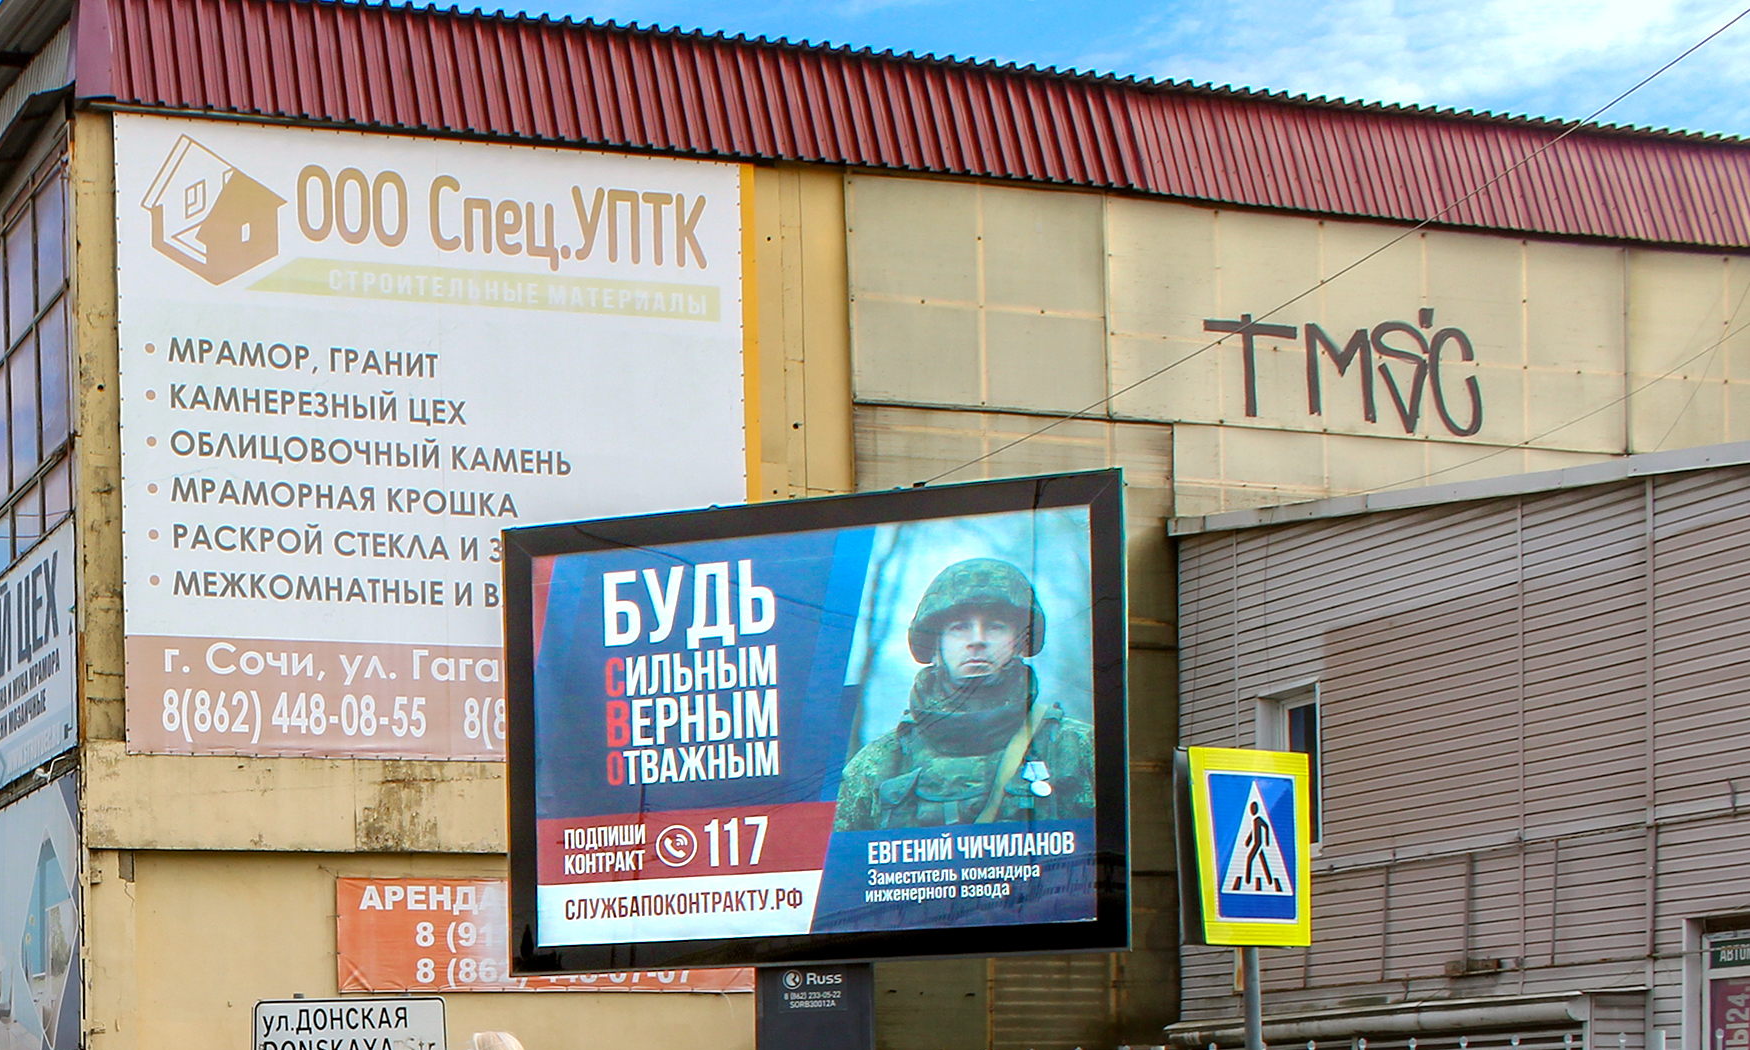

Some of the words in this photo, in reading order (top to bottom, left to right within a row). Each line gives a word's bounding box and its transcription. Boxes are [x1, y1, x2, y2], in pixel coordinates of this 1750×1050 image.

[296, 164, 409, 248] ООО
[428, 174, 709, 271] Спец.УПТК
[329, 269, 540, 304] СТРОИТЕЛЬНЫЕ
[547, 283, 707, 316] МАТЕРИАЛЫ
[168, 337, 320, 375] МРАМОР,
[328, 348, 439, 378] ГРАНИТ
[169, 384, 398, 424] КАМНЕРЕЗНЫЙ
[409, 398, 467, 426] ЦЕХ
[170, 429, 440, 470] ОБЛИЦОВОЧНЫЙ
[452, 445, 572, 476] КАМЕНЬ
[171, 477, 376, 511] МРАМОРНАЯ
[387, 488, 518, 518] КРОШКА
[173, 523, 323, 556] РАСКРОЙ
[334, 532, 449, 561] СТЕКЛА
[460, 537, 478, 562] И
[17, 550, 59, 664] ЦЕХ
[173, 571, 444, 606] МЕЖКОМНАТНЫЕ
[455, 581, 473, 607] И
[602, 559, 776, 649] БУДЬ
[163, 648, 190, 673] г.
[205, 642, 326, 681] Сочи,
[340, 653, 397, 685] ул.
[604, 645, 778, 699] СИЛЬНЫМ
[162, 688, 261, 744] 8(862)
[272, 692, 427, 738] 448-08-55
[606, 688, 779, 749] ВЕРНЫМ
[606, 742, 780, 787] ОТВАЖНЫМ
[564, 824, 646, 850] ПОДПИШИ
[703, 815, 769, 868] 117
[564, 849, 646, 875] КОНТРАКТ
[867, 832, 953, 865] ЕВГЕНИЙ
[956, 831, 1075, 859] ЧИЧИЛАНОВ
[865, 885, 957, 903] инженерного
[960, 882, 1011, 899] взвода
[868, 868, 958, 886] Заместитель
[961, 864, 1041, 882] командира
[564, 888, 804, 921] СЛУЖБАПОКОНТРАКТУ.РФ
[415, 921, 435, 948] 8
[416, 957, 436, 984] 8
[805, 972, 844, 985] Russ
